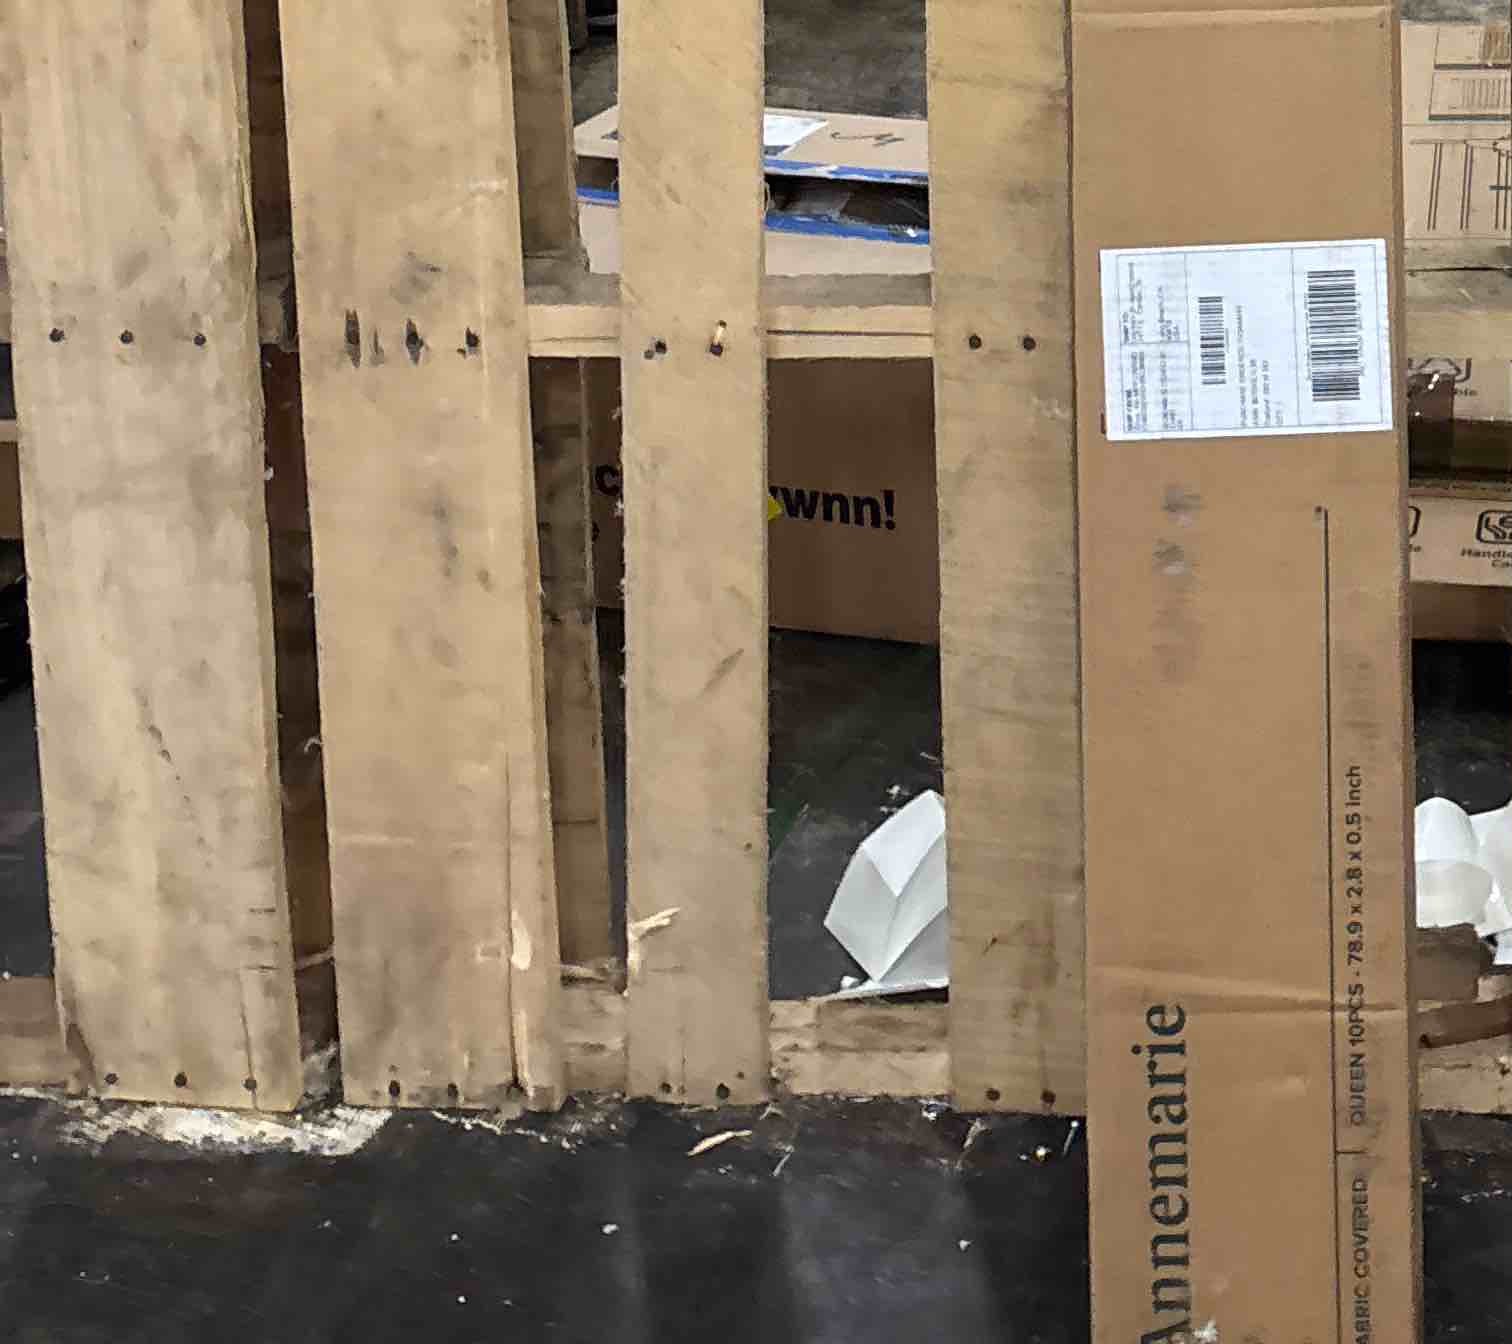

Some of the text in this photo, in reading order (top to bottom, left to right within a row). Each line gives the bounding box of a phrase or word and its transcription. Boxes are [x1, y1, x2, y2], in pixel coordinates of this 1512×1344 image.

[1345, 813, 1363, 845] 0.5
[1349, 850, 1362, 861] x
[1346, 867, 1364, 899] 2.8
[1350, 904, 1363, 916] x
[1347, 922, 1365, 966] 78.9
[1348, 982, 1367, 1047] 10PCS
[1348, 1052, 1368, 1126] QUEEN
[1351, 1178, 1371, 1278] COVERED
